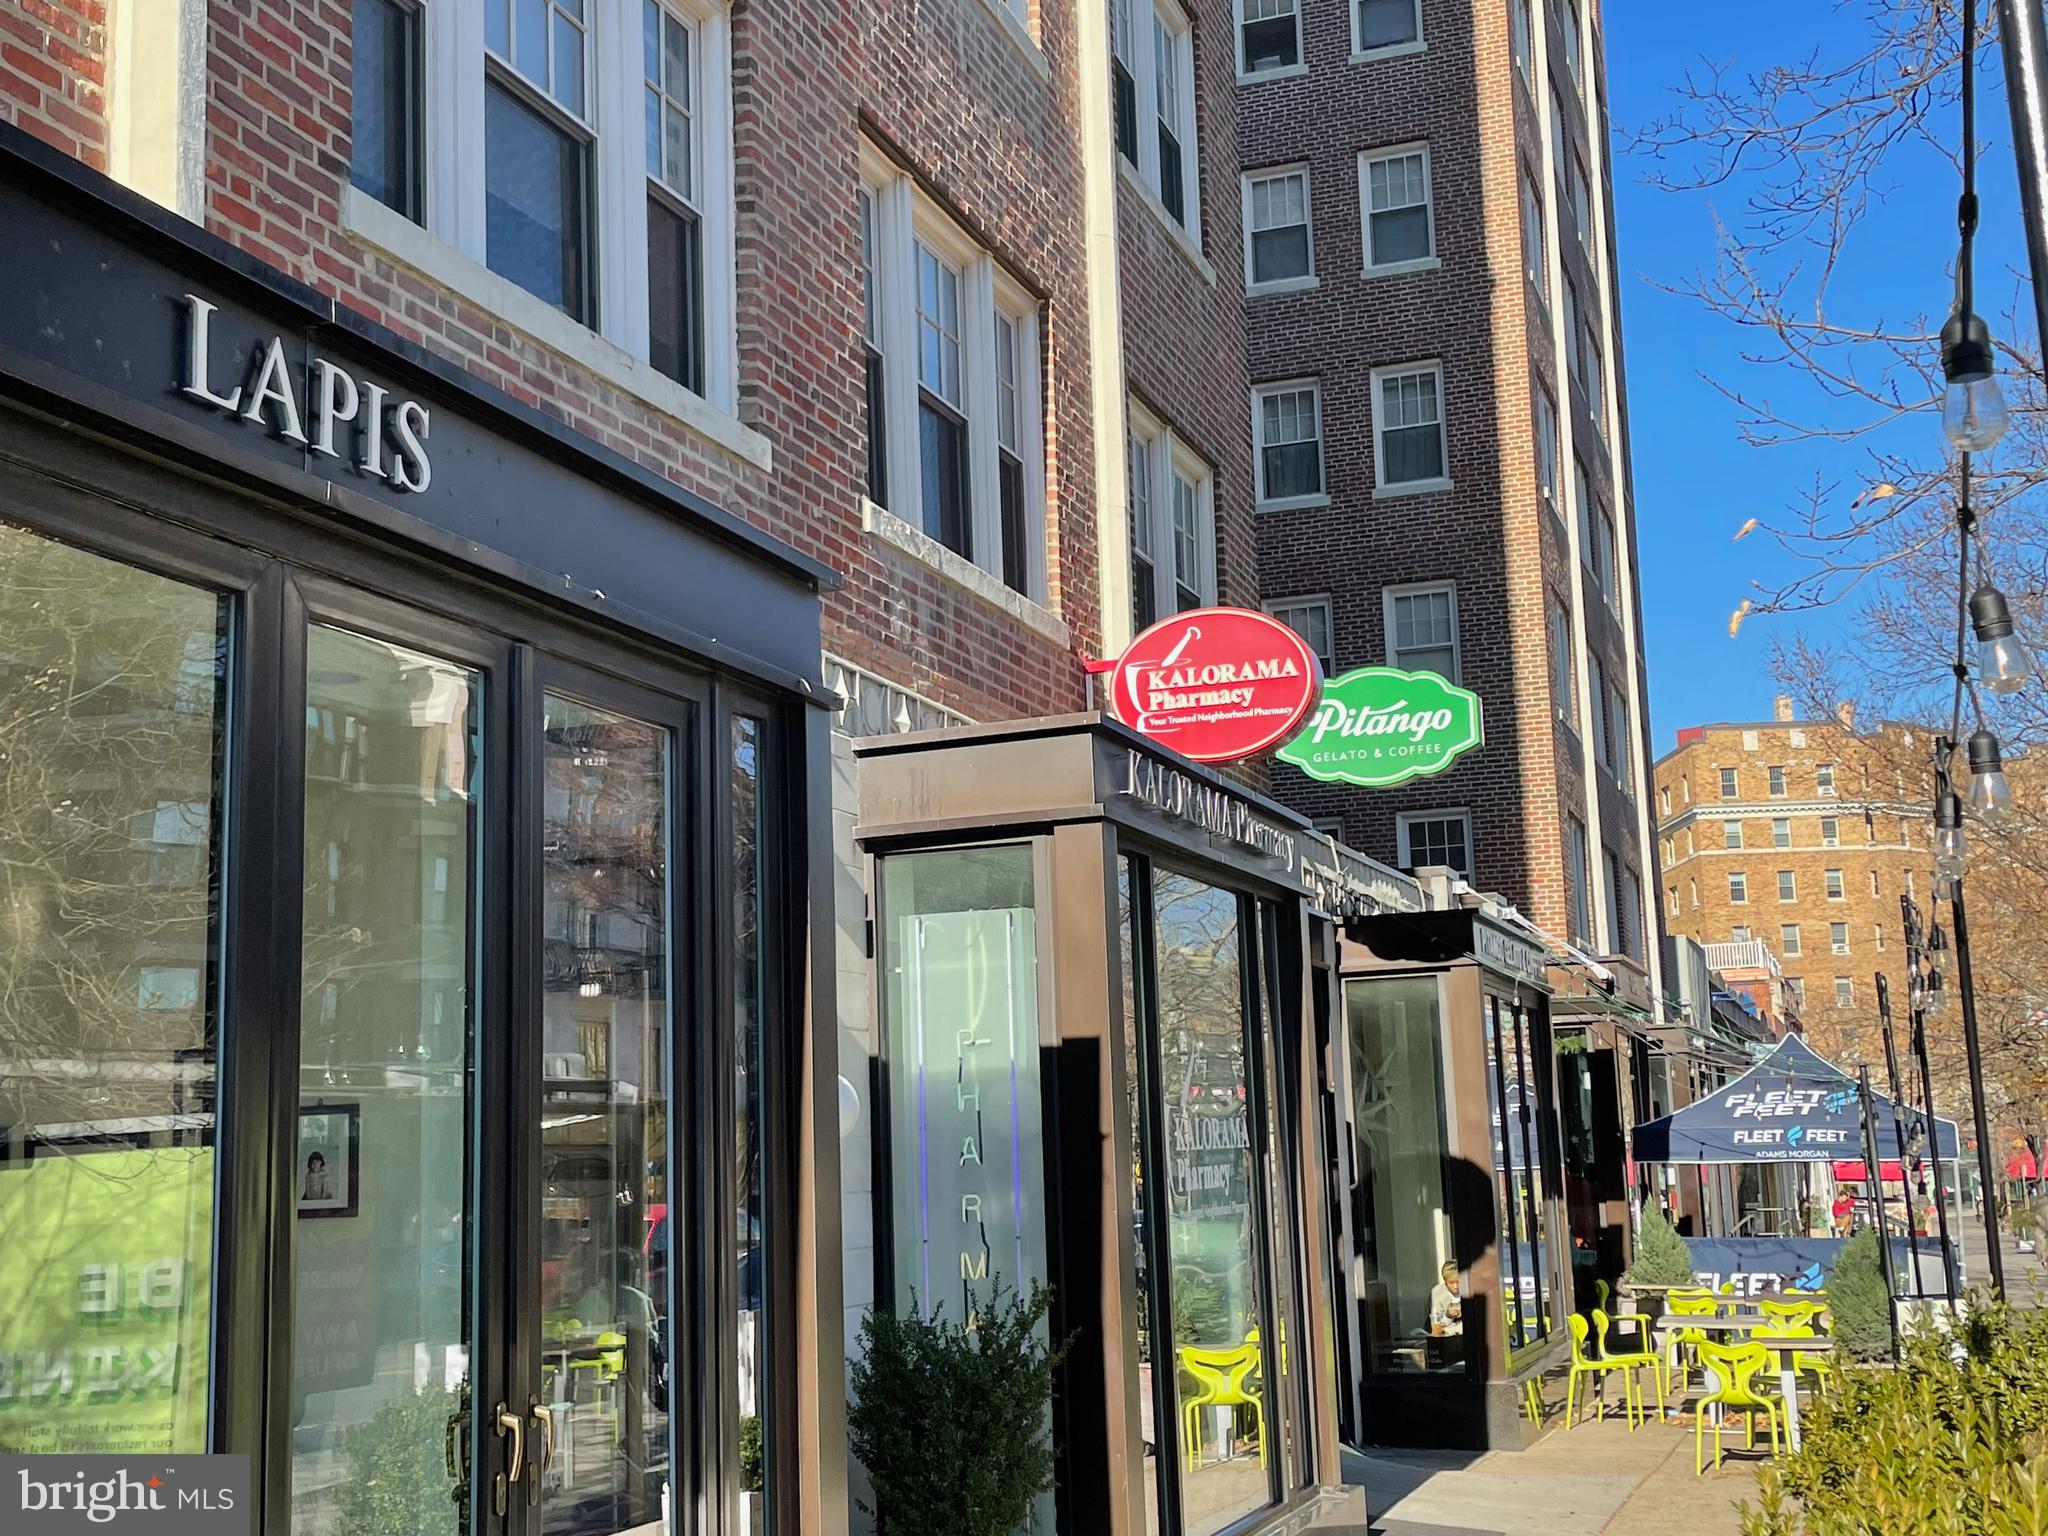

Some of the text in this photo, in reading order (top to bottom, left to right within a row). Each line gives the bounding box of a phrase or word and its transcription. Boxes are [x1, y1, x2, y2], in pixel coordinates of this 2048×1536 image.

[183, 293, 432, 493] LAPIS
[1147, 657, 1299, 690] KALORAMA
[1147, 687, 1254, 711] Pharmacy
[1149, 706, 1293, 726] Your Trusted Neighborhood Pharmacy
[1309, 698, 1452, 743] Pitango
[1313, 743, 1441, 763] GELATO & COFFEE
[1128, 748, 1233, 838] KALORAMA
[1725, 1090, 1828, 1108] FLEET
[1733, 1103, 1819, 1118] FEET
[1174, 1116, 1250, 1151] KALORAMA
[1733, 1129, 1848, 1143] FLEET FEET
[1756, 1150, 1829, 1158] ADAMS MORGAN
[956, 1029, 990, 1335] PHARM
[1177, 1158, 1231, 1197] Pharmacy
